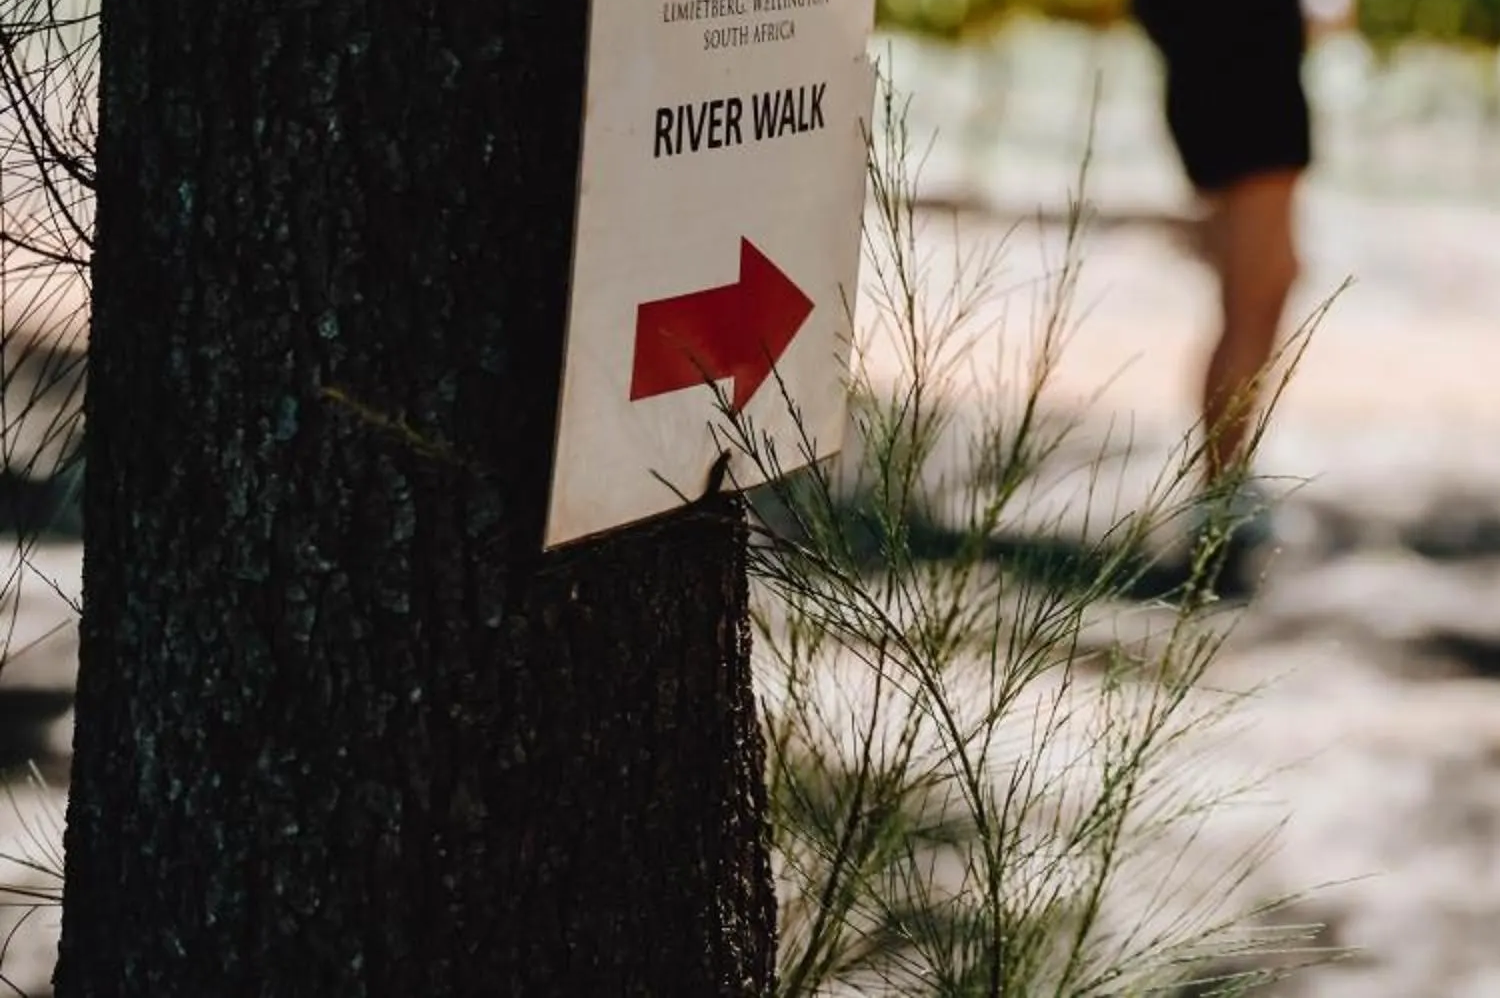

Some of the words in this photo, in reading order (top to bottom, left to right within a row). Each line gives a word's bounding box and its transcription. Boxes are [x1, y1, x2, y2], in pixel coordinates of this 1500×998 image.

[704, 25, 749, 51] SOUTH
[752, 18, 796, 44] AFRICA
[654, 97, 744, 158] RIVER
[752, 83, 827, 140] WALK
